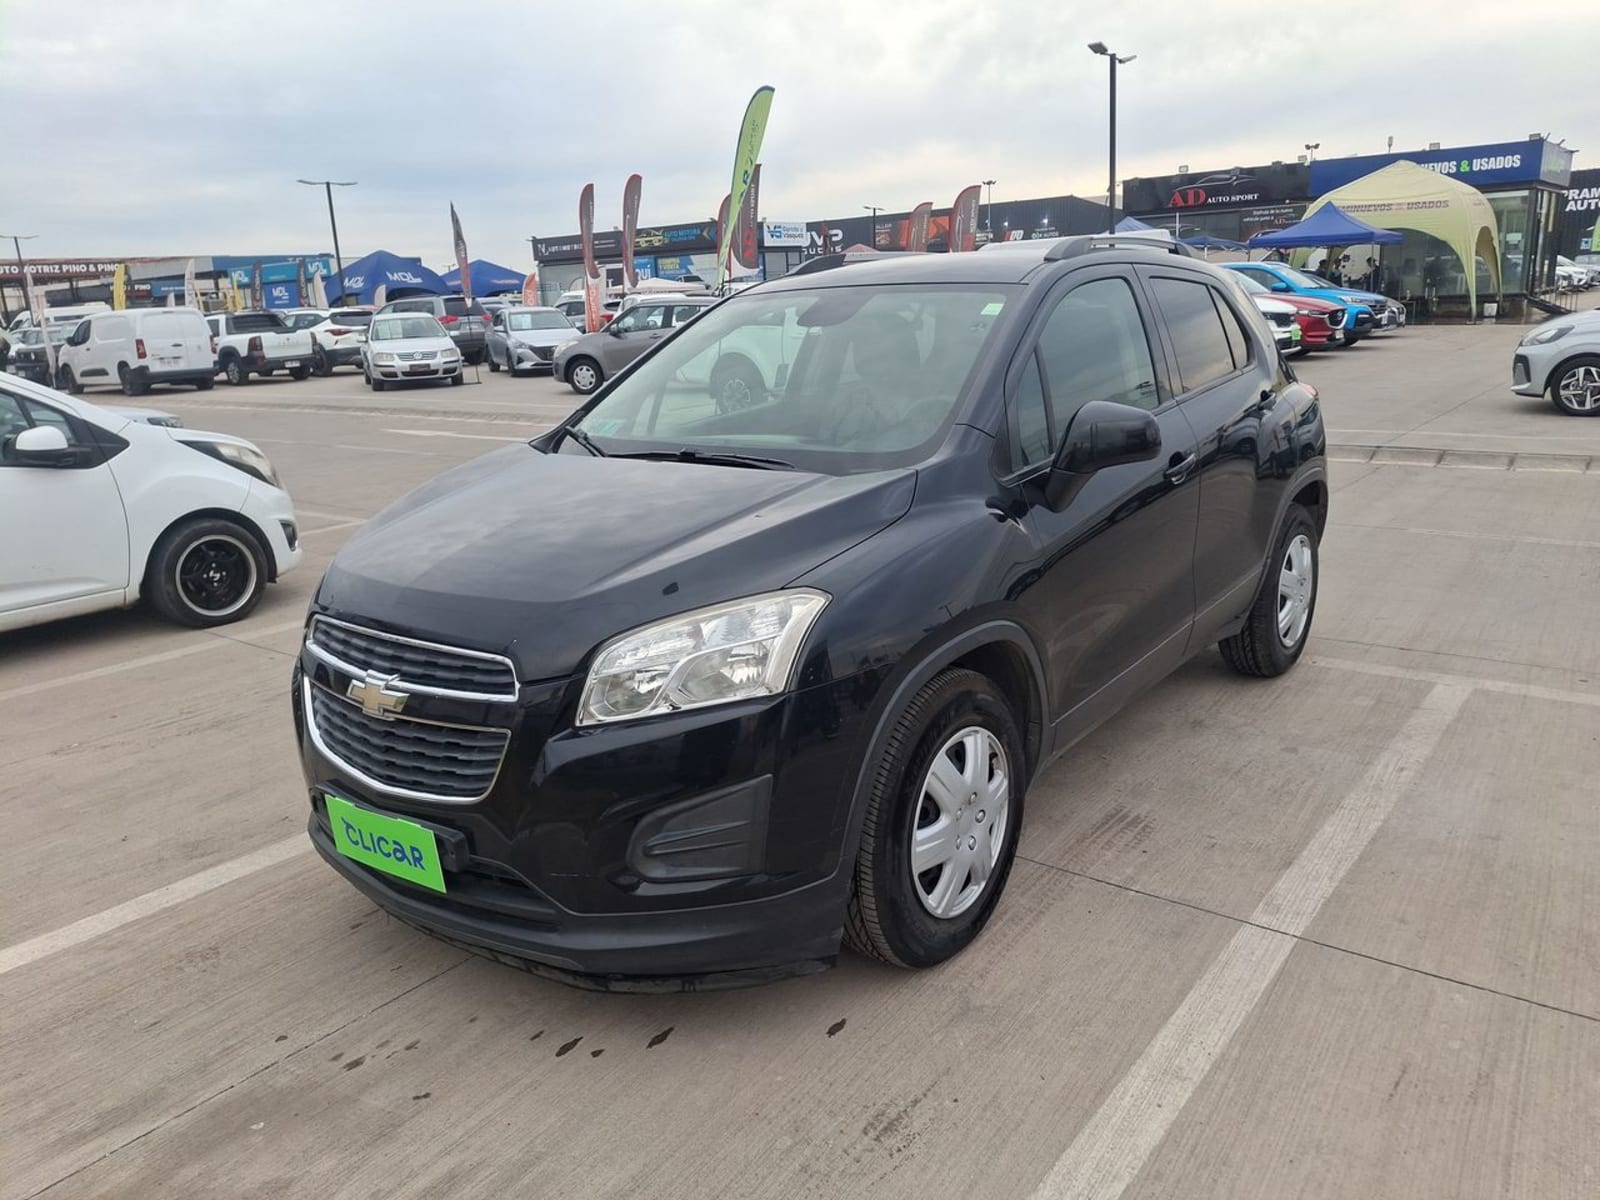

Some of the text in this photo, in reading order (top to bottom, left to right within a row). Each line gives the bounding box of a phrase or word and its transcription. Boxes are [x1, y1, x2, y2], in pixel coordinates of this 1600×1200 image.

[1460, 160, 1470, 172] &
[1472, 155, 1521, 171] USADOS
[1168, 189, 1260, 208] AD AUTO SPORT
[1565, 199, 1600, 212] AUT
[62, 264, 87, 272] PINO
[89, 264, 96, 272] &
[385, 271, 423, 283] MDL
